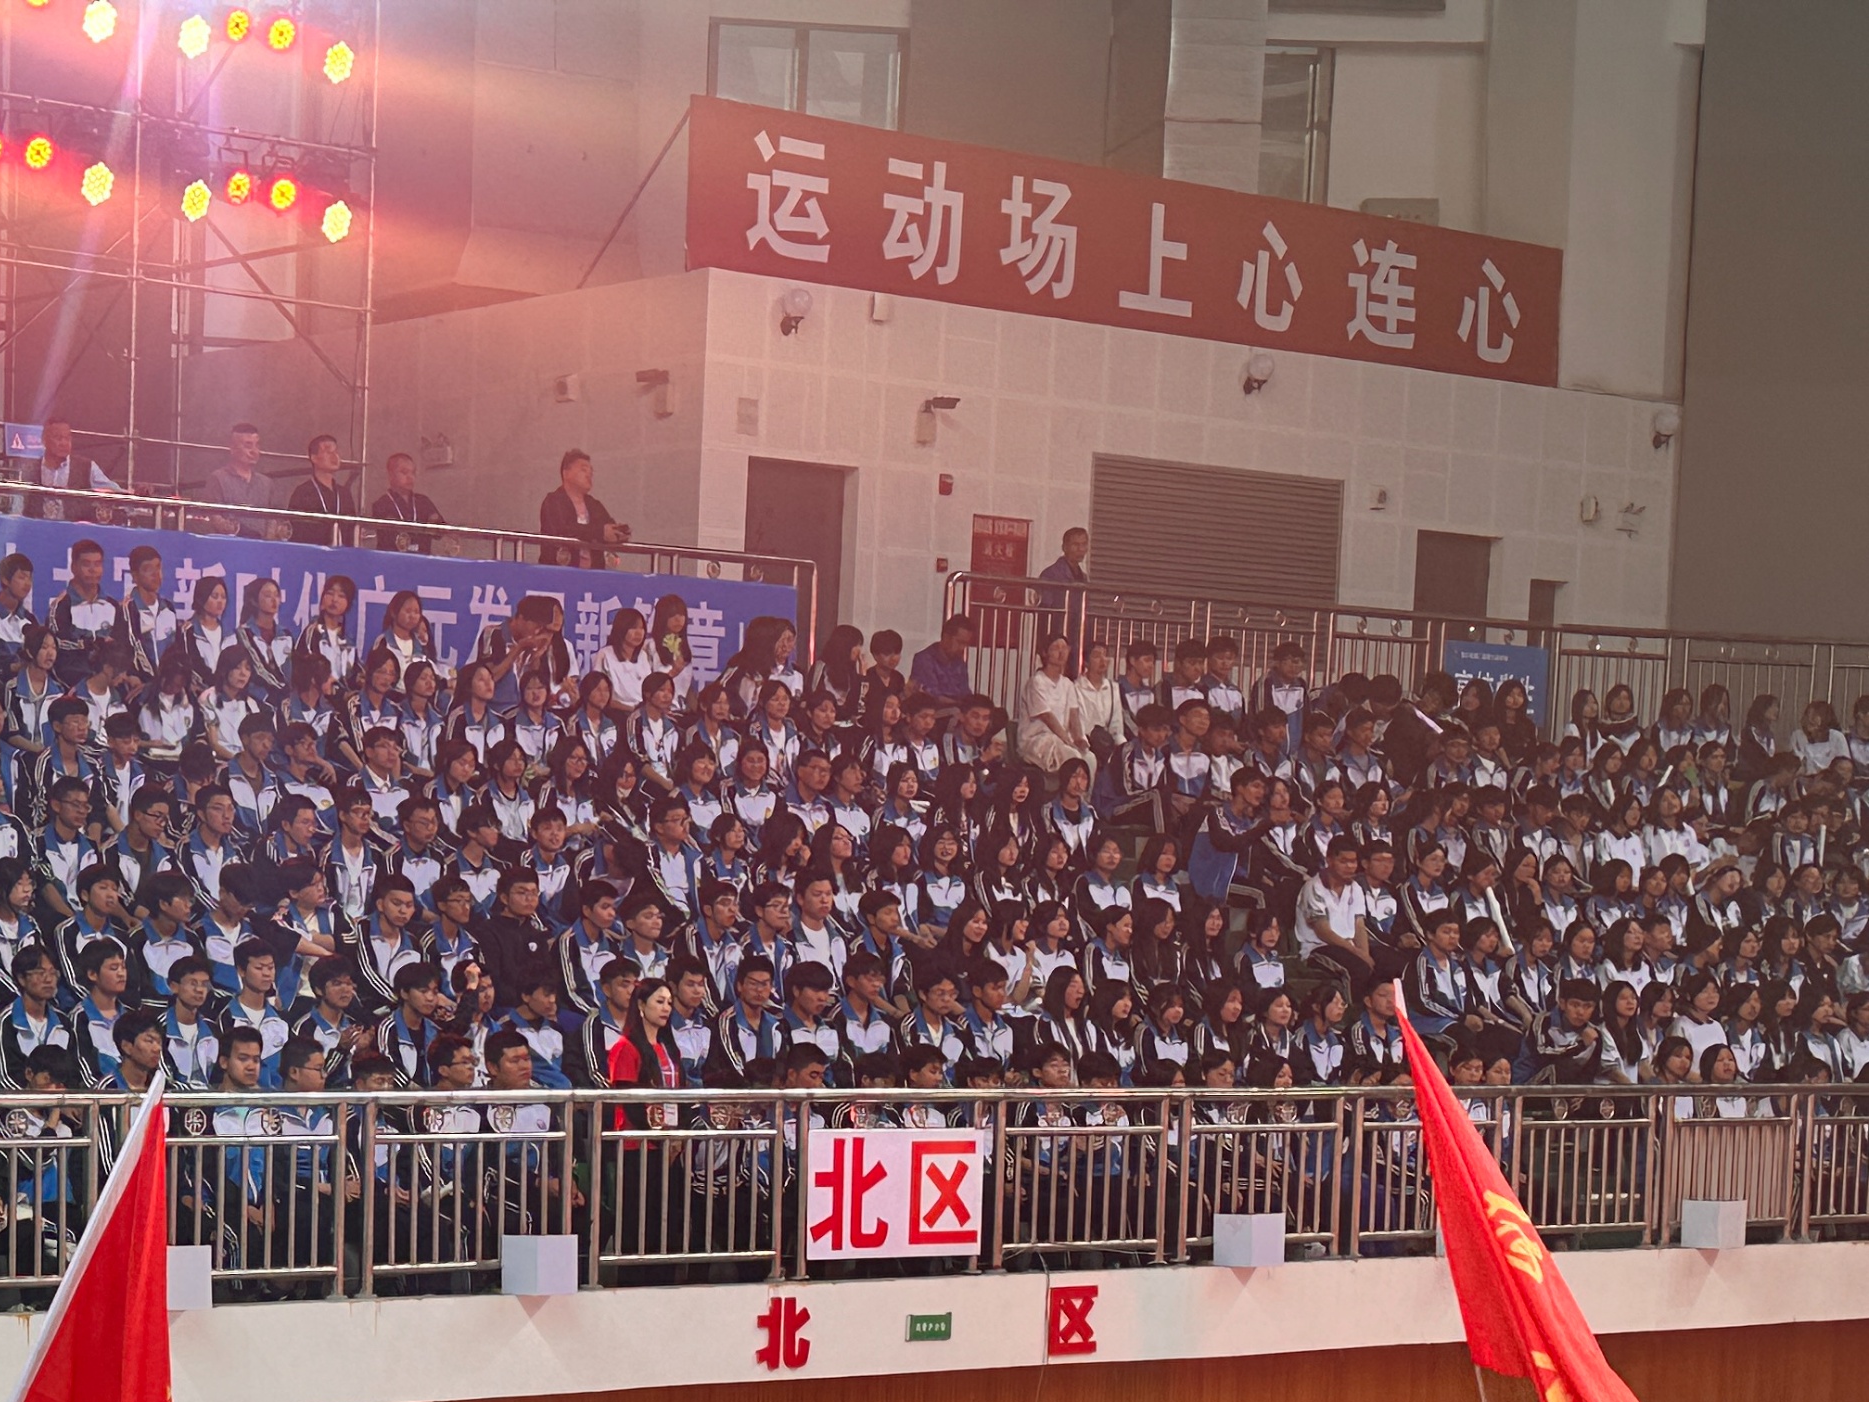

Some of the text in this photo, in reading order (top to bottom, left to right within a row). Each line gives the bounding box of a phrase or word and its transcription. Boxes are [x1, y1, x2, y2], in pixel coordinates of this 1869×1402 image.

[745, 130, 1522, 364] 运动场上心连心
[810, 1136, 978, 1251] 北区
[756, 1285, 1099, 1372] 北 区
